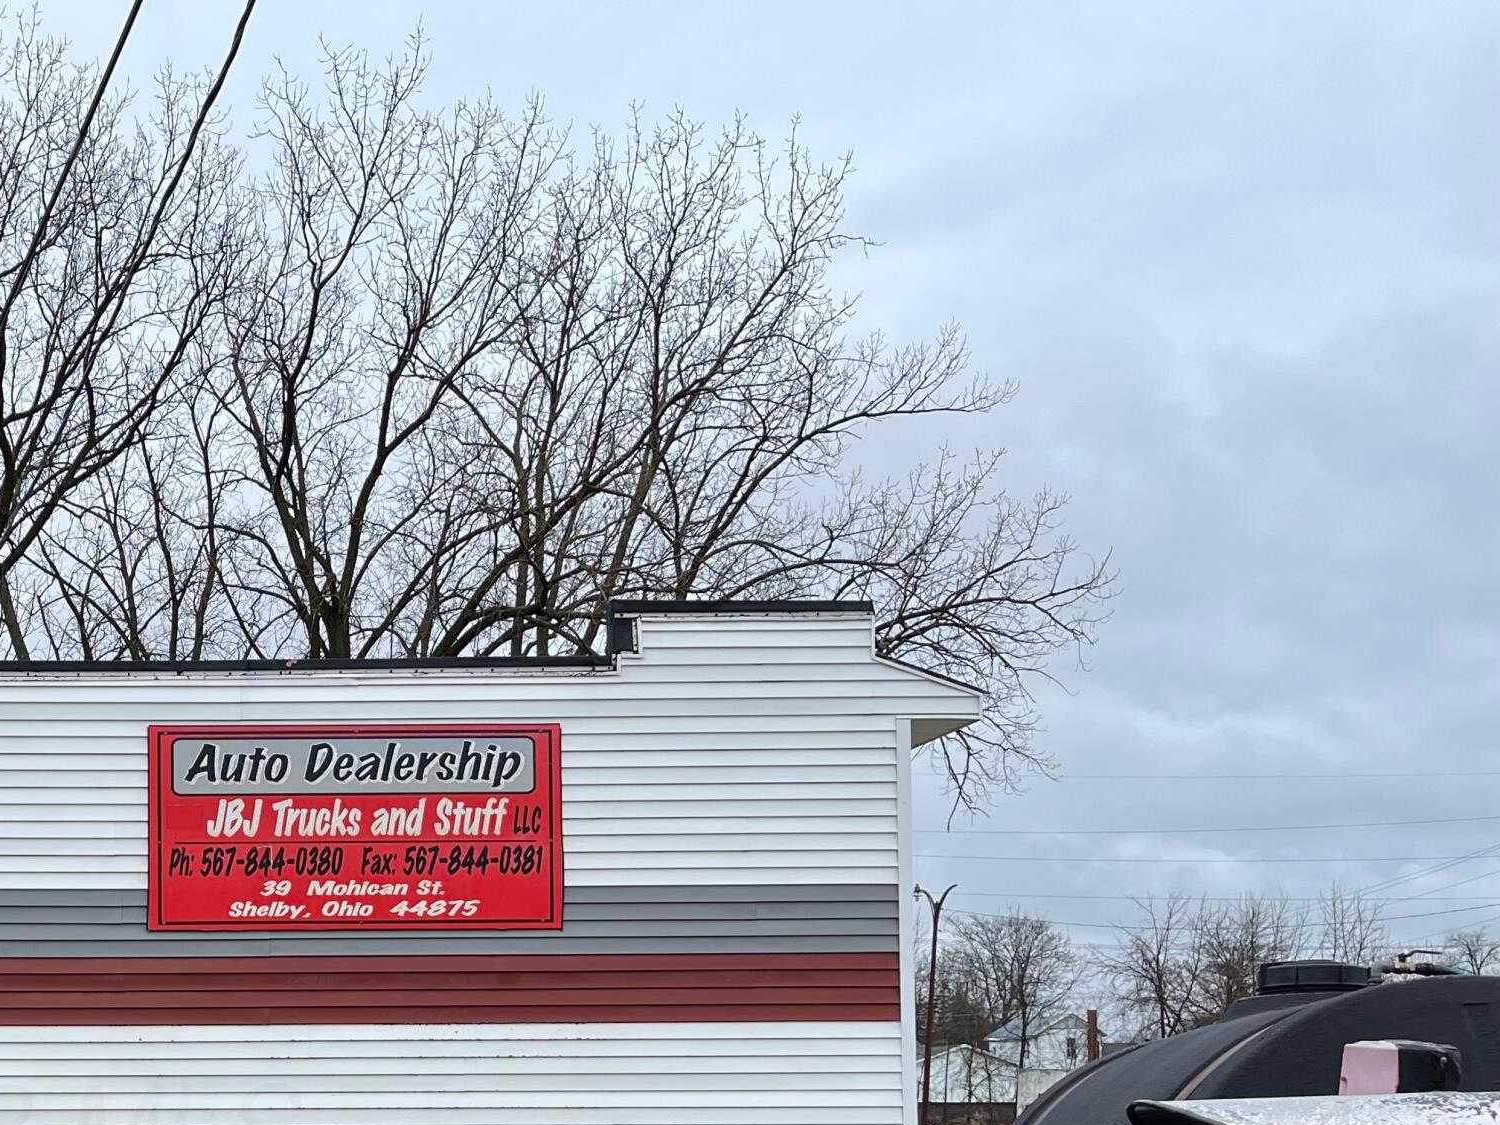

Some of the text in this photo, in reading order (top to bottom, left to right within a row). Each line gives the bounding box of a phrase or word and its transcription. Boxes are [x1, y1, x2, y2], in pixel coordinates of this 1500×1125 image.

[184, 740, 523, 788] Auto Dealership
[206, 797, 542, 838] JBJ Trucks and Stuff LLC
[168, 845, 544, 878] Ph: 567-844-0380 Fax: 567-844-0381
[259, 878, 445, 897] 39 Mohican St.
[228, 899, 481, 919] Shelby, Ohio 44875
